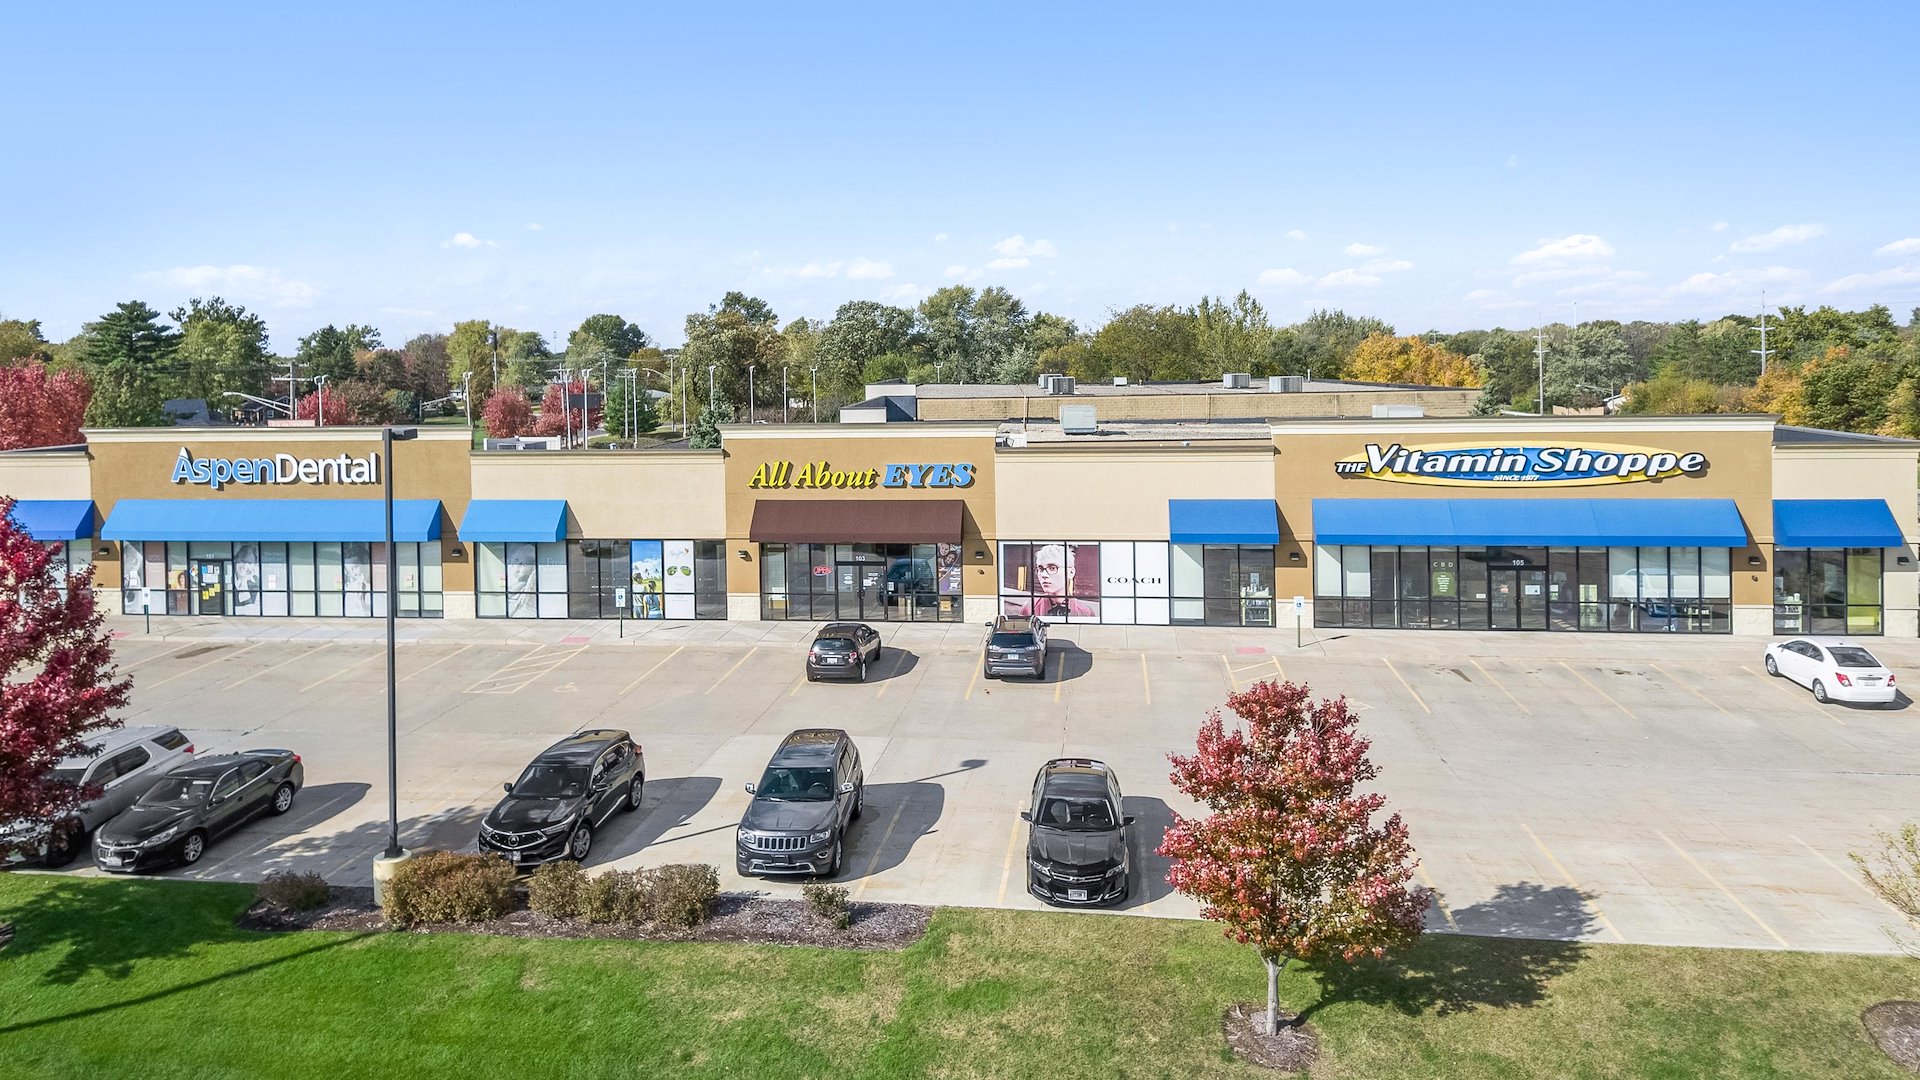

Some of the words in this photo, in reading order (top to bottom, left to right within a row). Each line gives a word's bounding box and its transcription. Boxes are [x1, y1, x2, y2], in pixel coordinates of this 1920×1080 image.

[747, 460, 788, 487] All
[792, 460, 877, 487] About
[882, 463, 973, 487] EYES
[1335, 462, 1366, 473] THE
[1365, 443, 1526, 474] Vitamin
[1533, 448, 1707, 478] Shoppe
